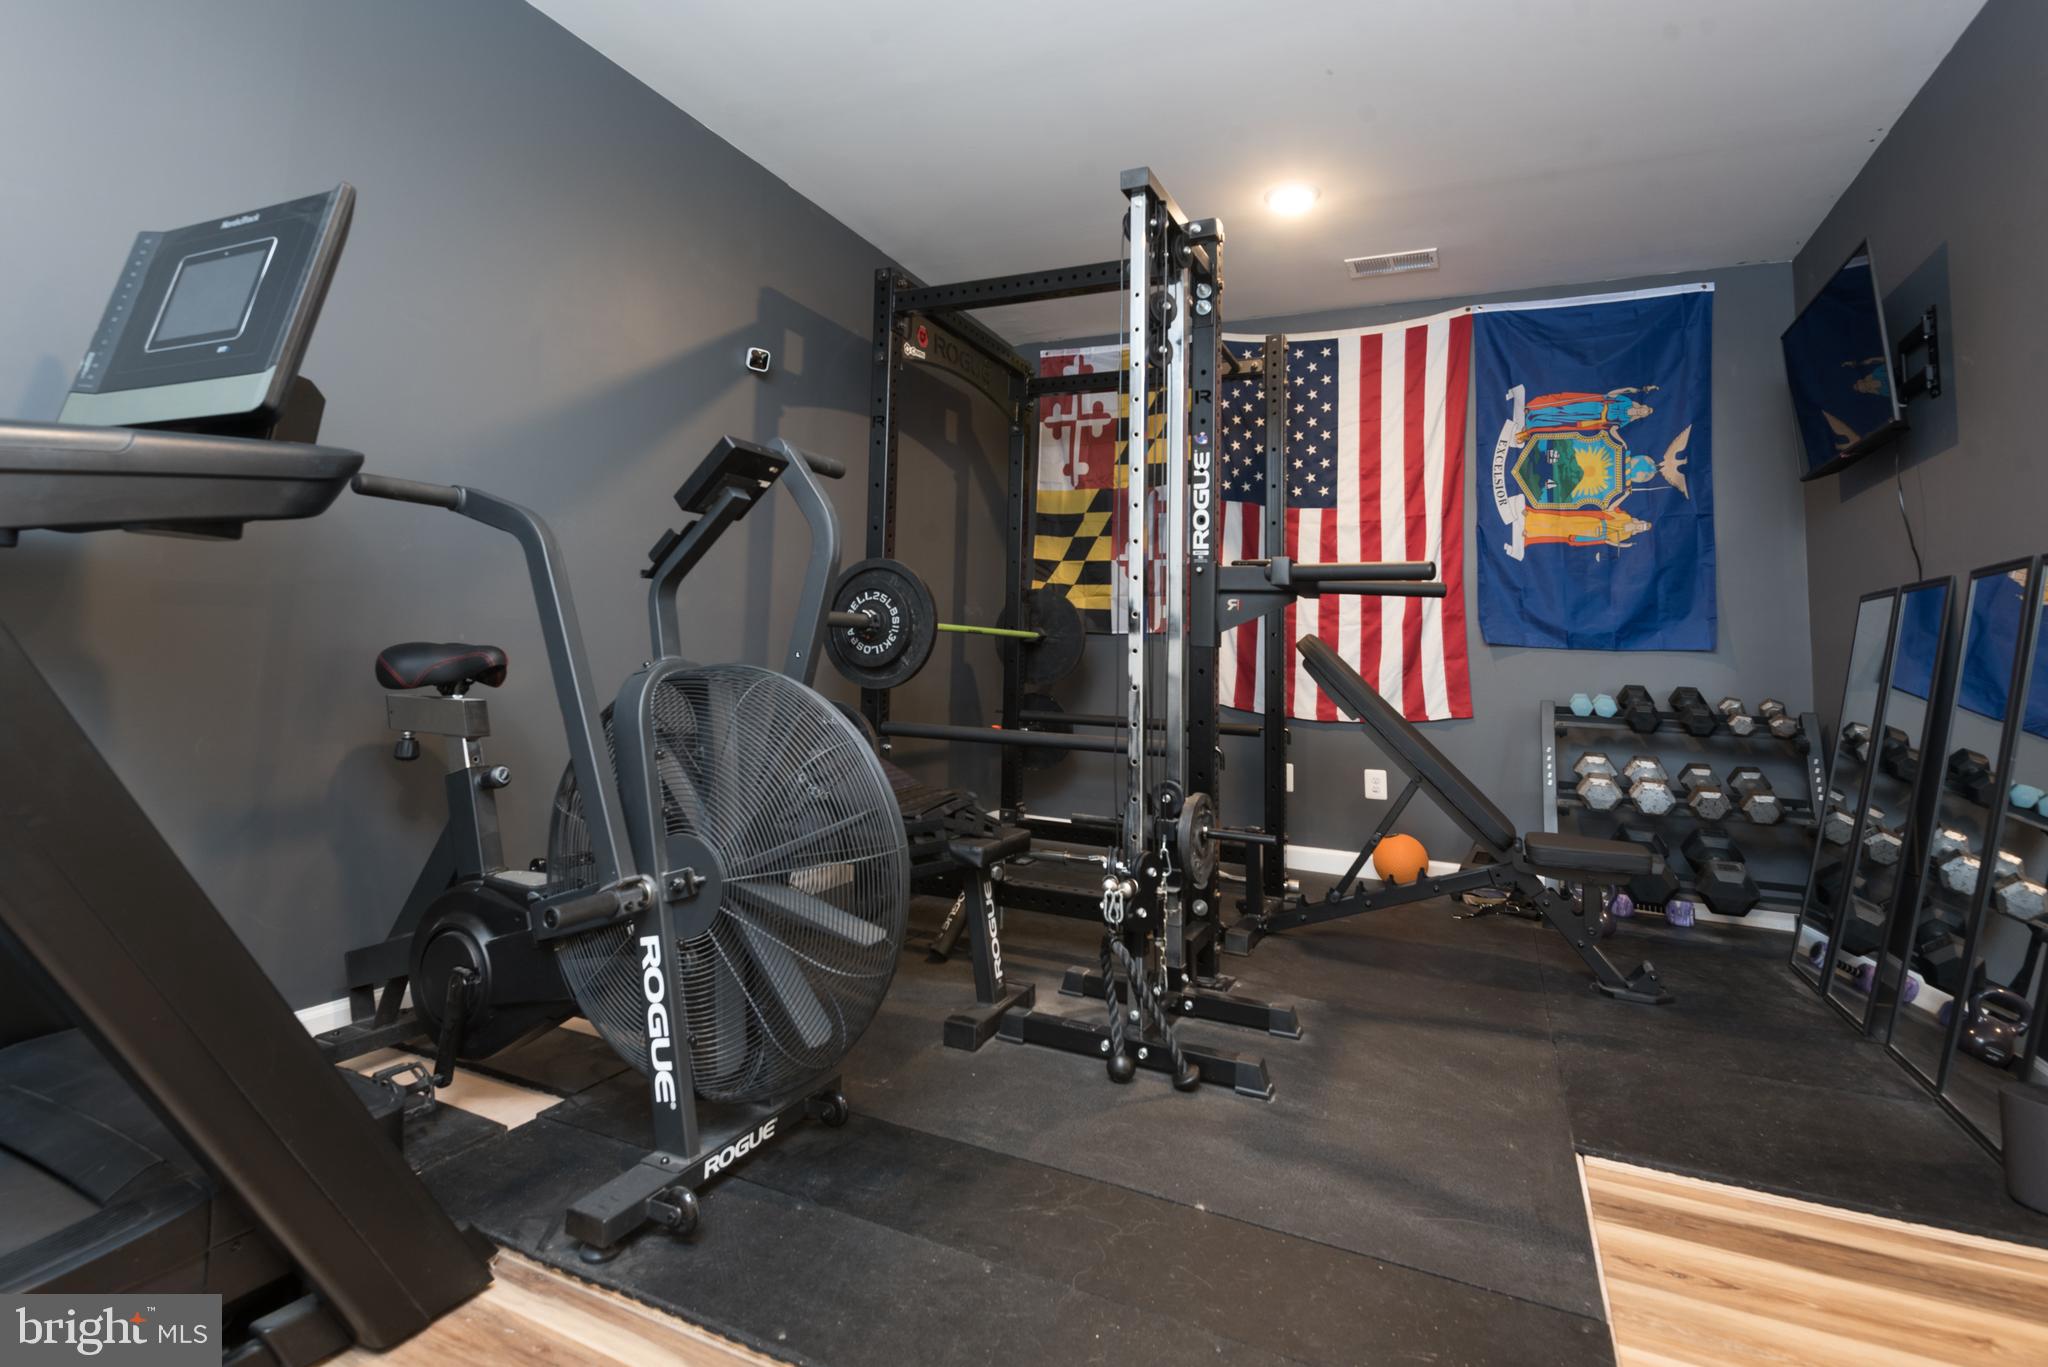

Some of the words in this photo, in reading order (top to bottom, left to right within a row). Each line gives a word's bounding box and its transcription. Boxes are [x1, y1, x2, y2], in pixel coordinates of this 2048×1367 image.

[1192, 451, 1211, 550] ROGUE
[1493, 440, 1508, 506] EXCELSIOR
[983, 880, 1004, 980] ROGUE
[639, 934, 675, 1104] ROGUE
[703, 1118, 777, 1180] ROGUE
